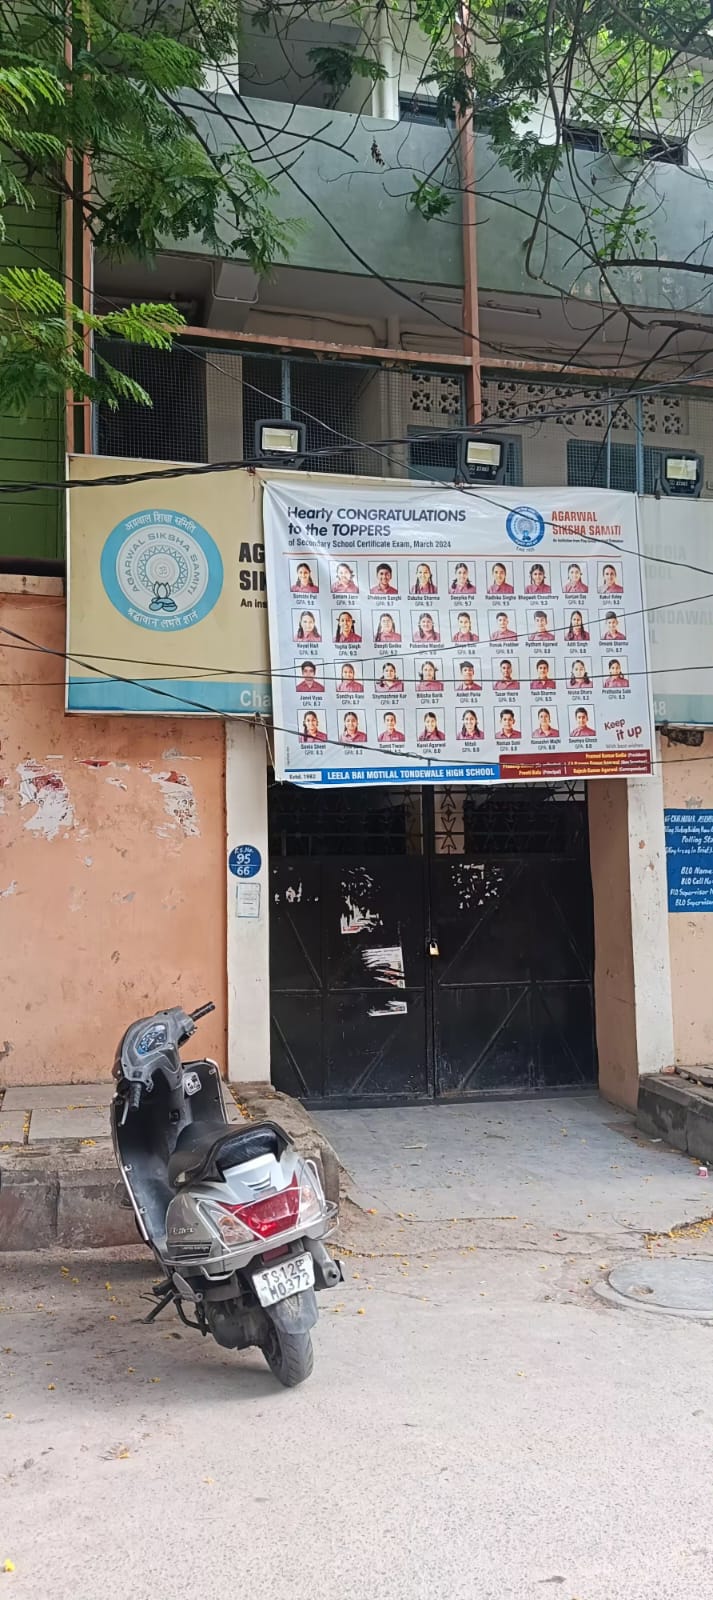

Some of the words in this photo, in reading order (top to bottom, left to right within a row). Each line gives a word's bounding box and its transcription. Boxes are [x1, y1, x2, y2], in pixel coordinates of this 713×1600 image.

[337, 508, 466, 522] CONGRATULATIONS
[552, 511, 598, 522] AGARWAL
[288, 523, 302, 535] to
[305, 523, 328, 536] the
[332, 524, 391, 536] TOPPERS
[552, 525, 586, 535] SIKSHA
[589, 525, 621, 536] SAMITI
[332, 540, 355, 548] School
[356, 540, 391, 548] Certificate
[392, 541, 412, 549] Exam,
[413, 540, 434, 548] March
[124, 539, 145, 592] AGARWAL
[147, 532, 190, 552] SIKSHA
[187, 554, 200, 595] SAMITI
[240, 598, 253, 608] An
[604, 719, 625, 731] Keep
[616, 729, 624, 741] it
[627, 726, 642, 739] up
[327, 771, 350, 780] LEELA
[351, 771, 364, 780] BAI
[366, 770, 398, 779] MOTILAL
[400, 769, 444, 778] TONDEWALE
[445, 769, 464, 777] HIGH
[465, 767, 495, 777] SCHOOL
[236, 853, 251, 865] 95
[236, 866, 250, 876] 66
